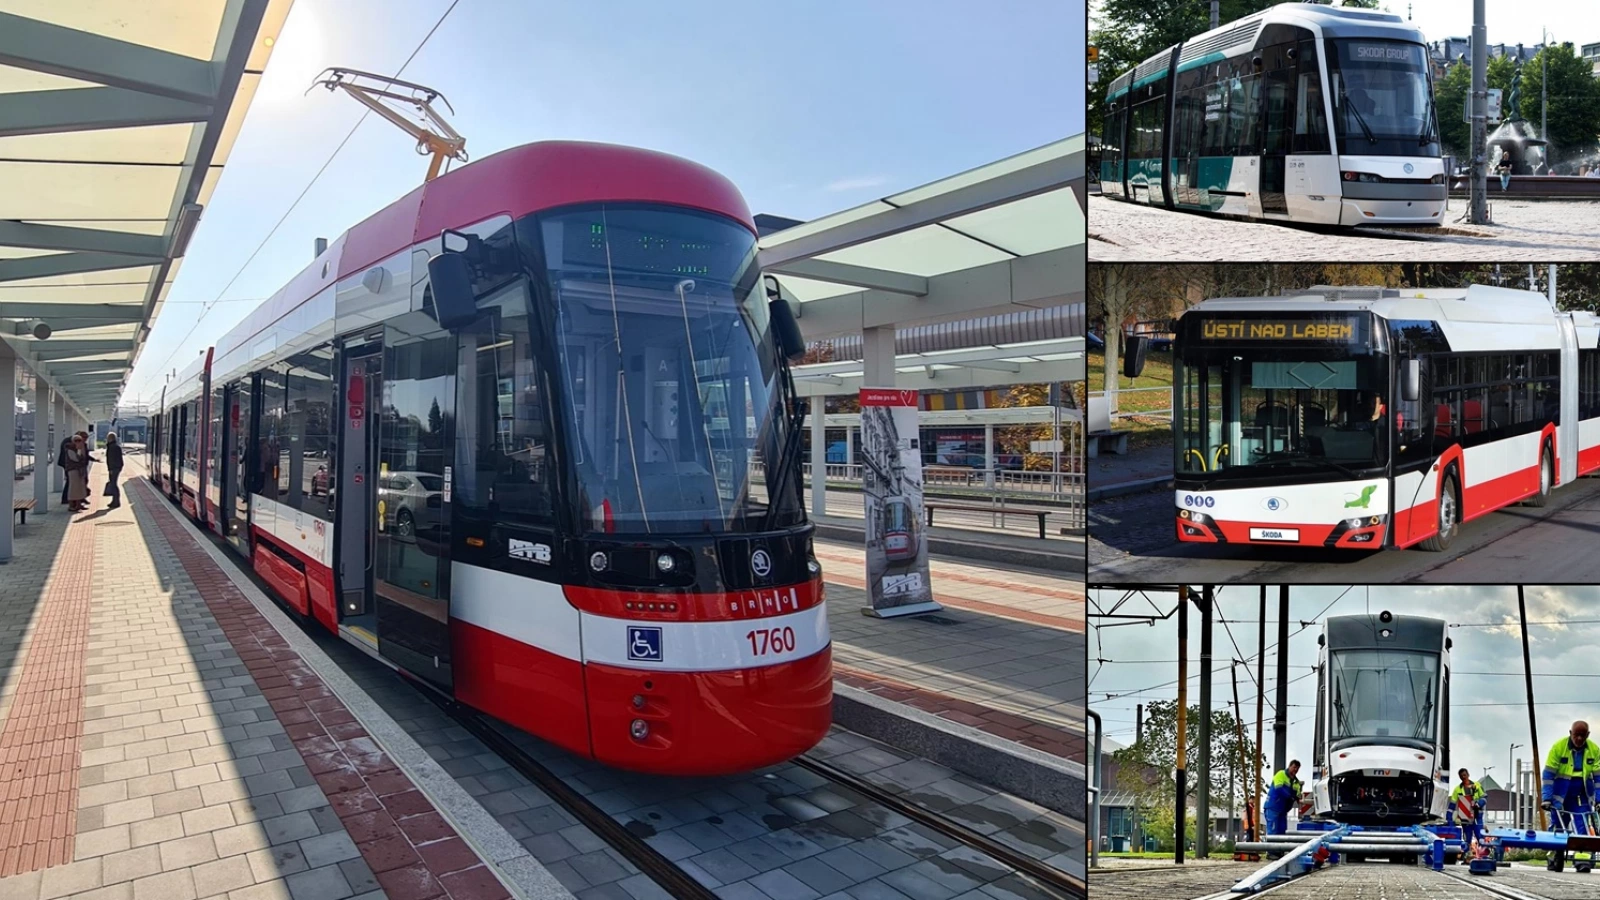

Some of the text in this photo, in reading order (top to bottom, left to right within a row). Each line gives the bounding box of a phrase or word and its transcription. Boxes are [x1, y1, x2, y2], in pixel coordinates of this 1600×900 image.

[1386, 48, 1410, 60] GROUP
[1203, 320, 1352, 338] ÚSTÍ NAD LABEM
[1261, 530, 1283, 538] ŠKODA
[746, 626, 796, 656] 1760
